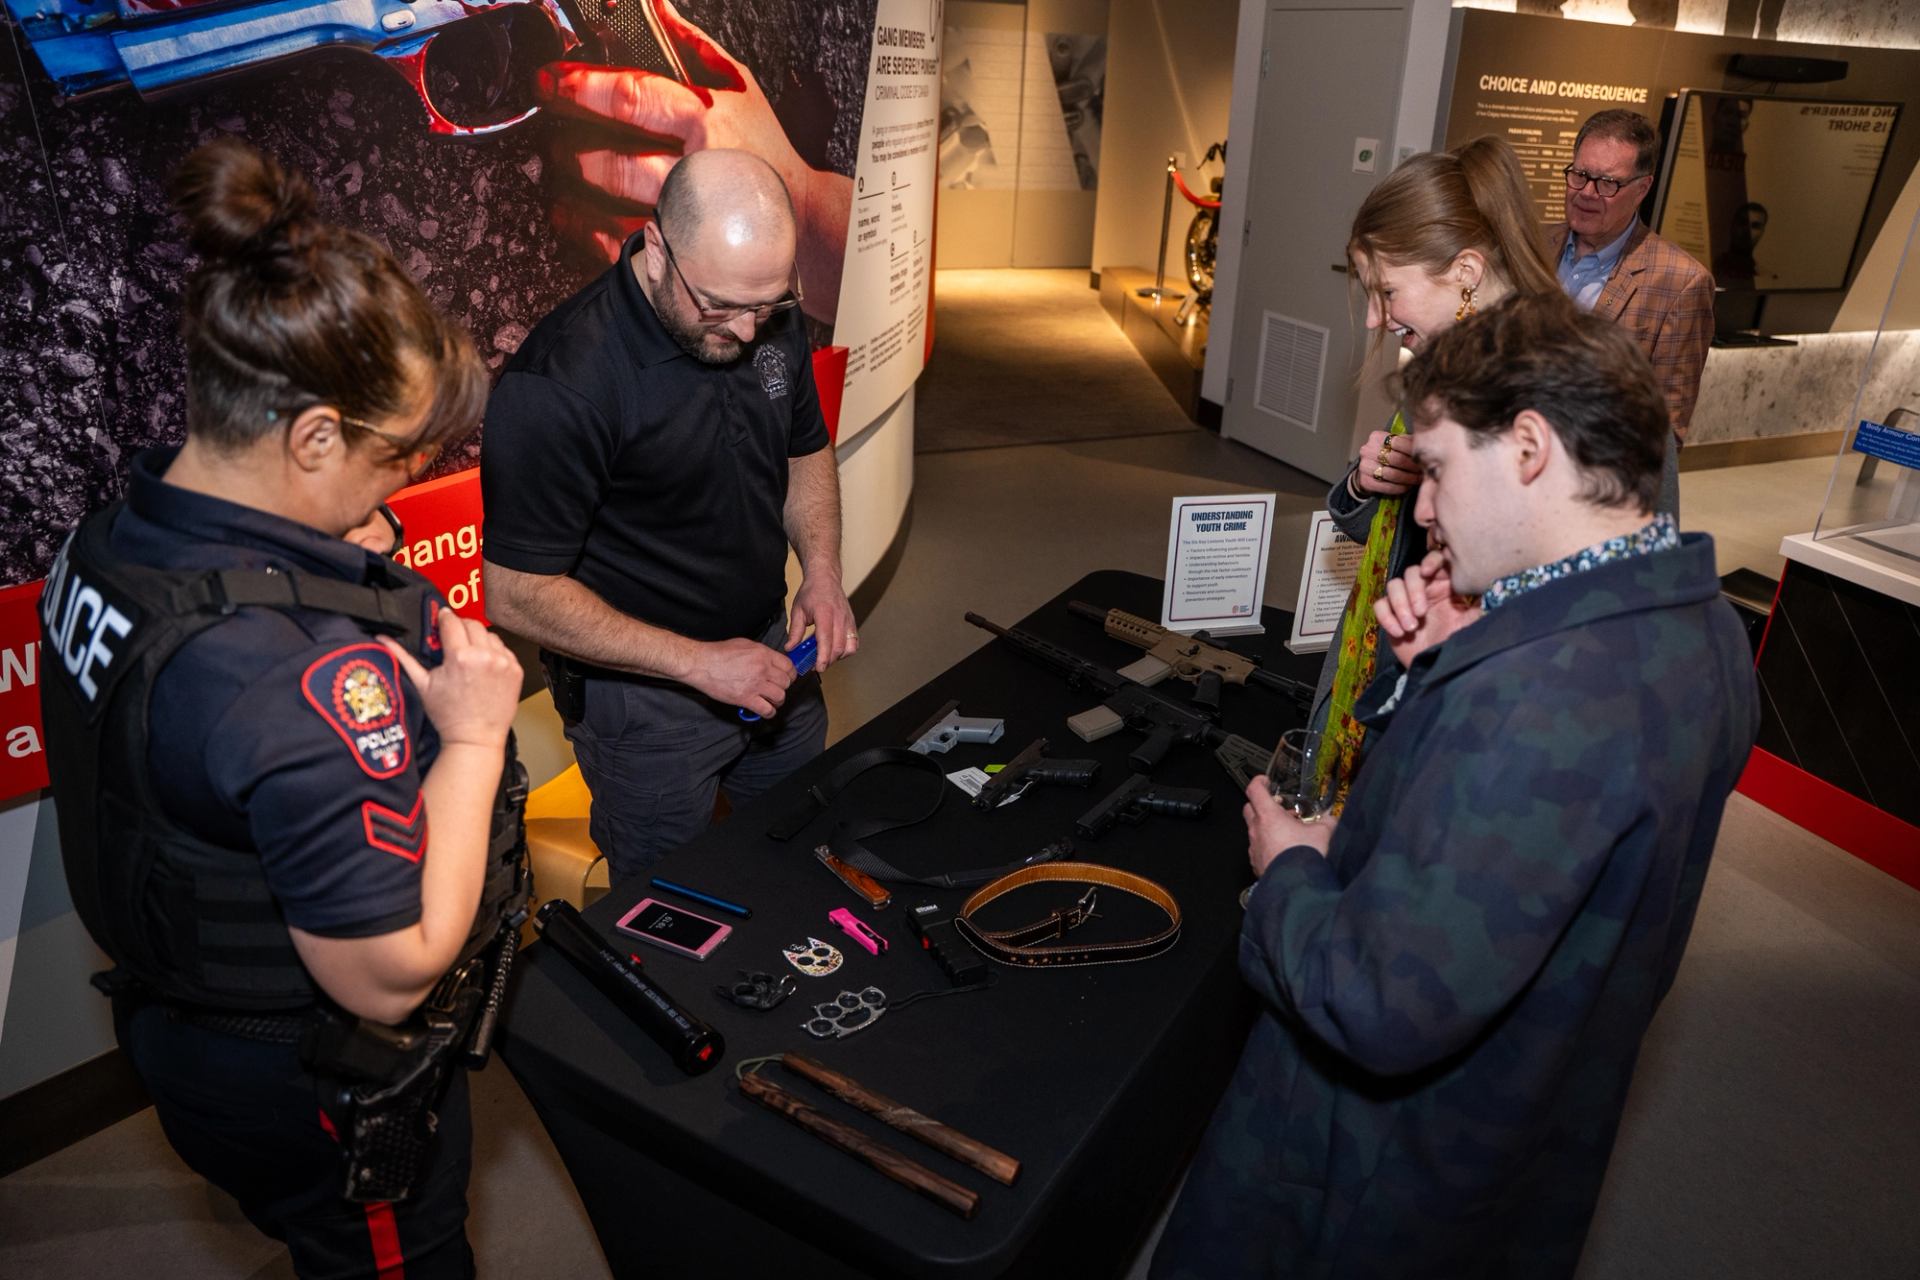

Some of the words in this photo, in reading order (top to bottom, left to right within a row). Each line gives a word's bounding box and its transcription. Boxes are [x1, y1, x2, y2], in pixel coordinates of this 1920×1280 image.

[877, 26, 898, 48] GANG
[899, 28, 926, 49] MEMBERS
[876, 56, 892, 75] ARE
[875, 86, 899, 101] CRIMINAL
[1480, 75, 1528, 94] CHOICE
[1529, 80, 1557, 96] AND
[1558, 81, 1648, 103] CONSEQUENCE
[1905, 434, 1920, 443] Con
[1191, 510, 1253, 521] UNDERSTANDING
[1196, 523, 1221, 532] YOUTH
[1223, 522, 1247, 531] CRIME
[448, 568, 480, 610] of
[356, 724, 406, 754] POLICE
[915, 904, 939, 914] STORM
